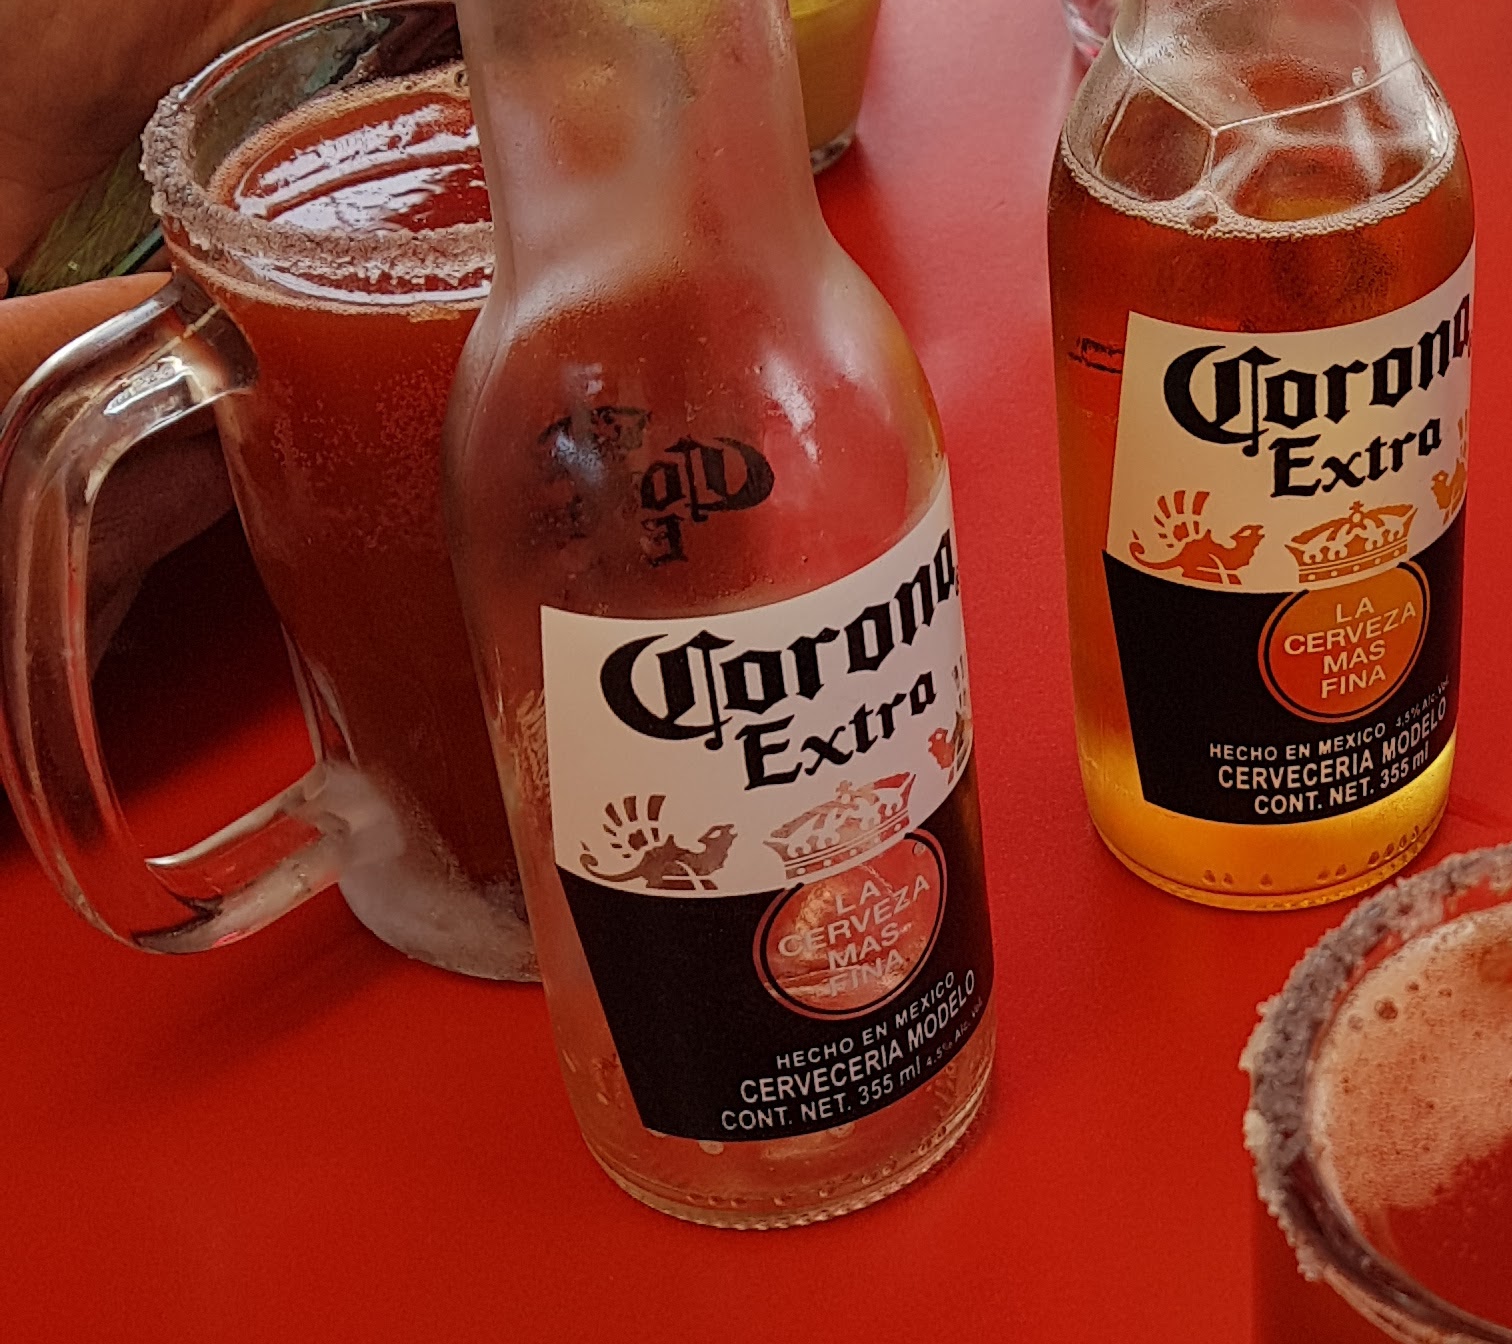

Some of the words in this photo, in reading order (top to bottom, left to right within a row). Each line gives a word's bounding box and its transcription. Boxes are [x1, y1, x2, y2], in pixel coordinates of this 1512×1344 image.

[1162, 292, 1470, 458] Corona
[1268, 417, 1442, 498] Extra
[599, 528, 956, 751] Corona
[1284, 601, 1417, 655] CERVEZA
[1336, 596, 1375, 624] LA
[1321, 664, 1387, 699] FINA
[1323, 639, 1387, 675] MAS
[734, 671, 937, 791] Extra
[1209, 742, 1278, 762] HECHO
[1286, 742, 1311, 761] EN
[1318, 722, 1386, 756] MEXICO
[1218, 748, 1374, 791] CERVECERIA
[1382, 696, 1447, 764] MODELO
[1254, 790, 1323, 815] CONT.
[1329, 775, 1375, 807] NET.
[1380, 761, 1410, 789] 355
[1412, 740, 1430, 771] ml
[777, 874, 931, 957] CERVEZA
[835, 879, 882, 917] LA
[824, 922, 901, 972] MAS
[828, 948, 907, 997] FINA
[740, 1042, 904, 1103] CERVECERIA
[907, 969, 976, 1053] MODELO
[776, 1037, 854, 1070] HECHO
[862, 1021, 889, 1046] EN
[895, 970, 955, 1028] MEXICO
[721, 1105, 793, 1131] CONT.
[801, 1092, 852, 1123] NET.
[858, 1072, 895, 1106] 355
[899, 1056, 922, 1089] ml
